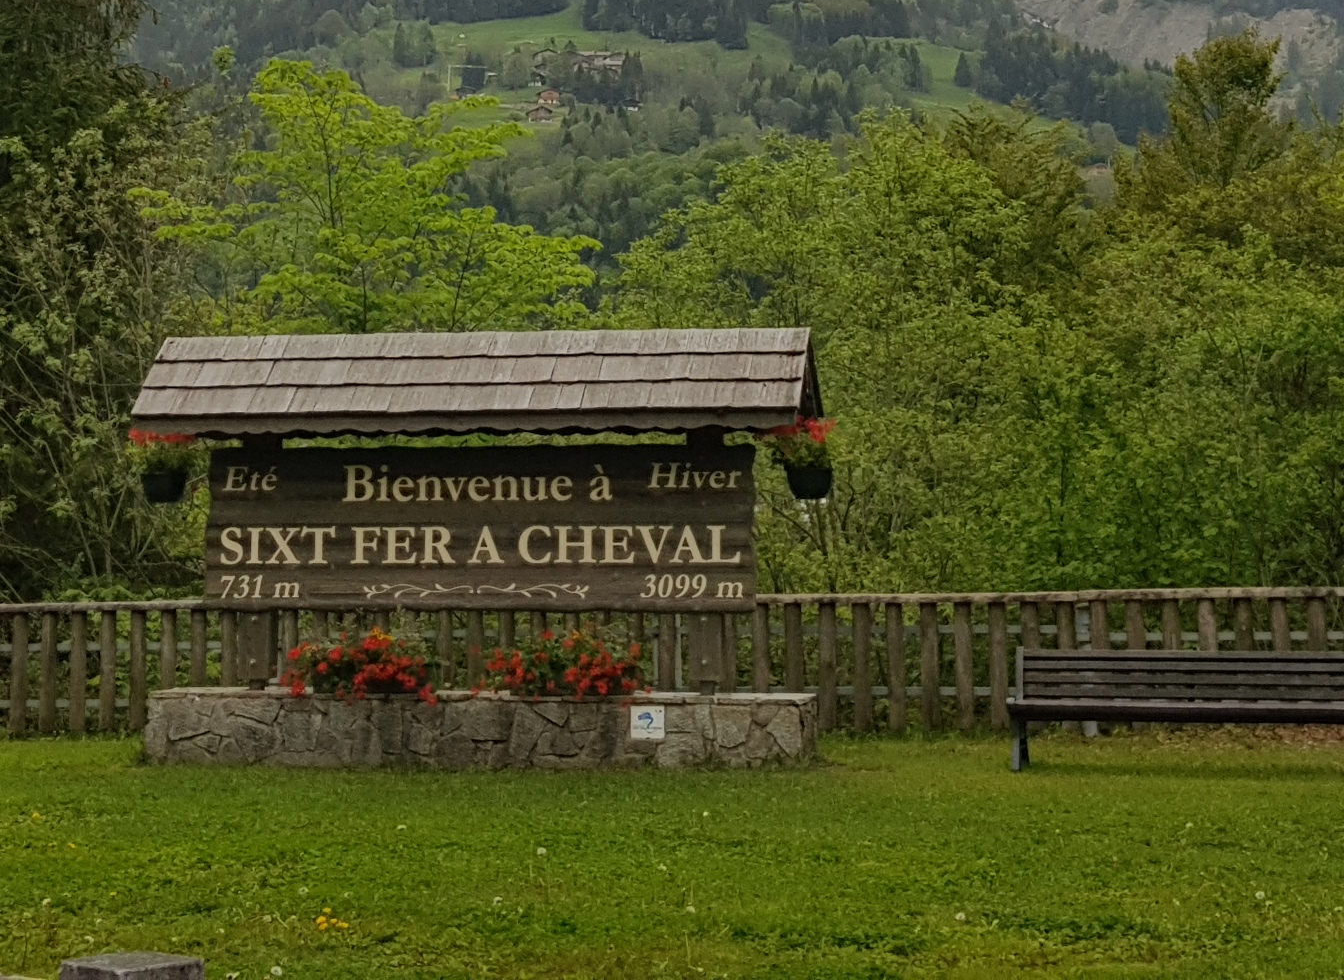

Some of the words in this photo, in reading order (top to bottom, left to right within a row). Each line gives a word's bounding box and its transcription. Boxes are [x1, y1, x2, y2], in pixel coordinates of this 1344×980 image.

[222, 465, 278, 492] Eté
[343, 465, 572, 502] Bienvenue
[589, 464, 613, 501] à
[648, 462, 742, 490] Hiver
[220, 526, 335, 565] SIXT
[351, 526, 455, 564] FER
[467, 526, 505, 564] A
[519, 525, 741, 564] CHEVAL
[220, 575, 264, 598] 731
[273, 582, 300, 598] m
[640, 575, 707, 598] 3099
[717, 582, 744, 598] m
